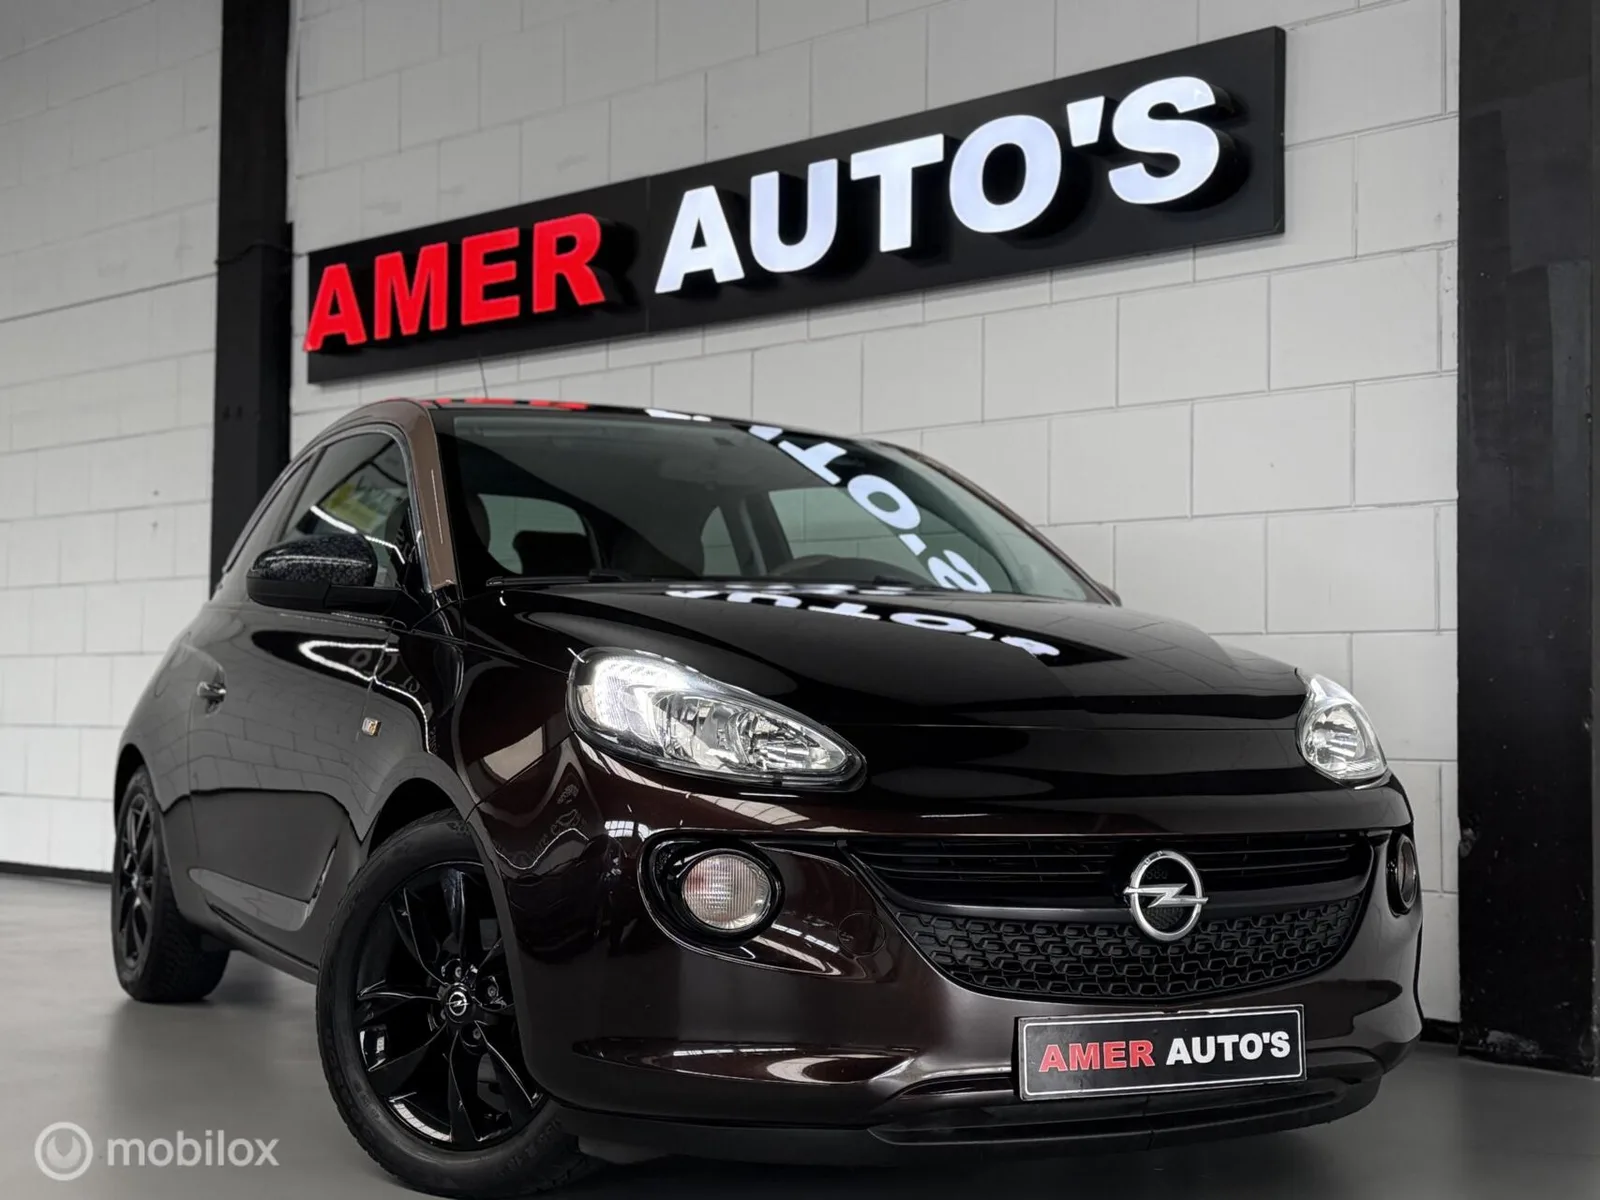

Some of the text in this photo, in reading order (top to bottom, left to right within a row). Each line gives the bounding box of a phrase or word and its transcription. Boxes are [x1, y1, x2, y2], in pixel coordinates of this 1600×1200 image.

[305, 75, 1220, 351] AMER AUTO'S
[1038, 1031, 1291, 1073] AMER AUTO'S
